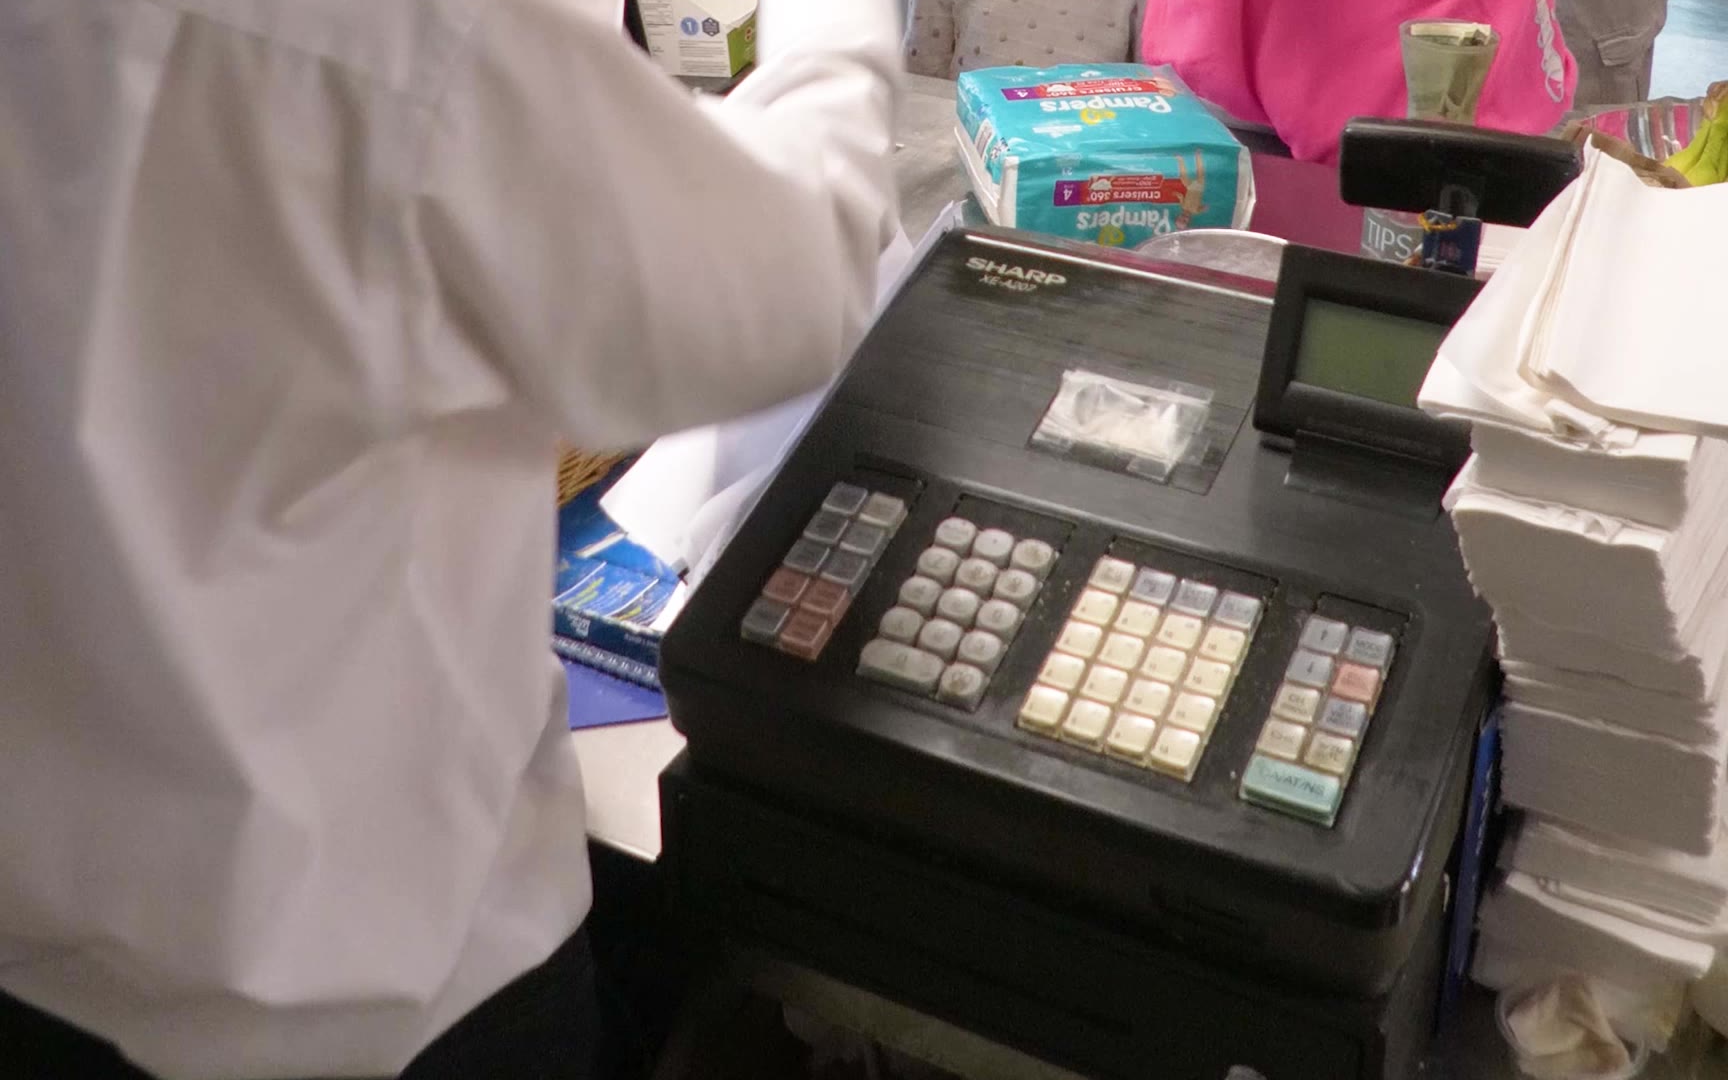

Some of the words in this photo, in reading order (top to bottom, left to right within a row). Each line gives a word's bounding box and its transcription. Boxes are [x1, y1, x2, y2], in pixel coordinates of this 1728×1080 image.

[1040, 94, 1172, 113] Pampers
[1063, 189, 1073, 201] 4
[1112, 190, 1162, 200] cruisers
[1076, 205, 1172, 236] Pampers
[1366, 216, 1413, 260] TIPS
[965, 256, 1067, 286] SHARP
